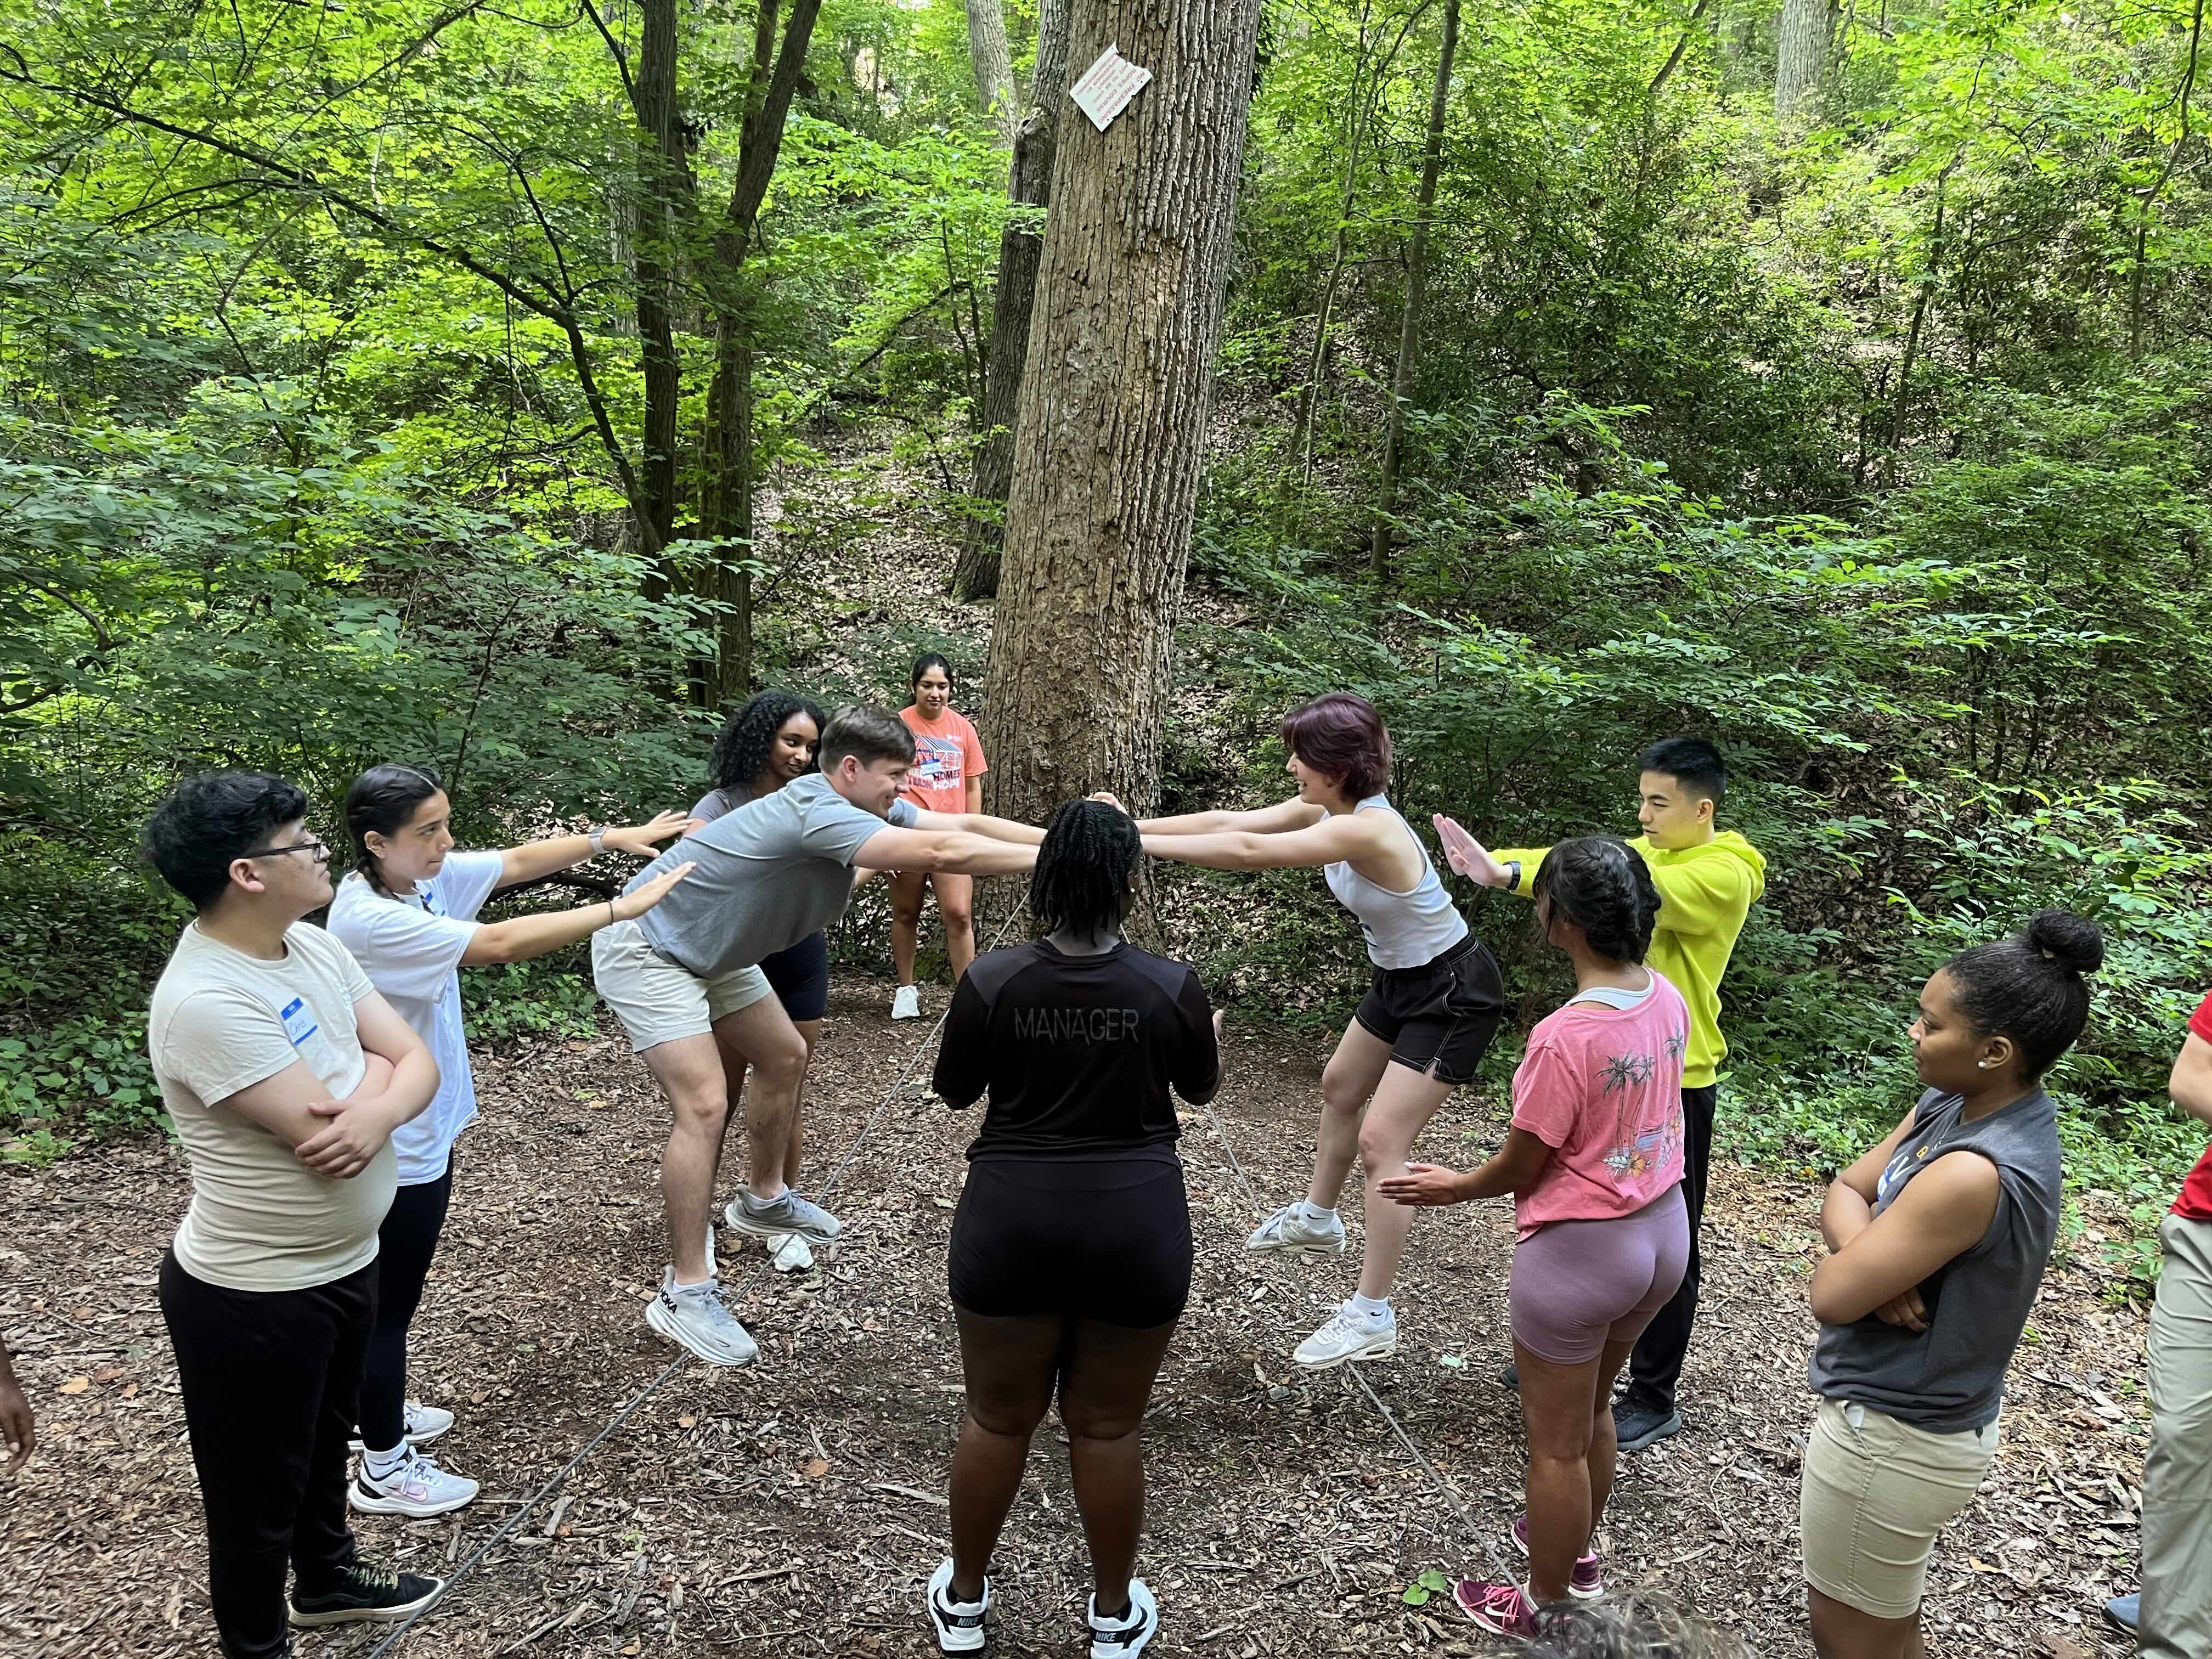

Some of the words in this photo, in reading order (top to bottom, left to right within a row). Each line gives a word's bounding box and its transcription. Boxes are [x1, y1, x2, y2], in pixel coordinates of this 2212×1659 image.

[1097, 69, 1116, 90] WITHOUT
[1118, 68, 1137, 88] ROPES
[1135, 71, 1146, 82] NO
[1096, 89, 1118, 113] COURSE
[1097, 83, 1136, 125] TRESPASSING
[933, 769, 960, 781] HOMES
[1014, 1007, 1139, 1046] MANAGER
[659, 1287, 678, 1314] HOKA
[957, 1616, 979, 1627] NIKE
[1096, 1632, 1116, 1642] NIKE
